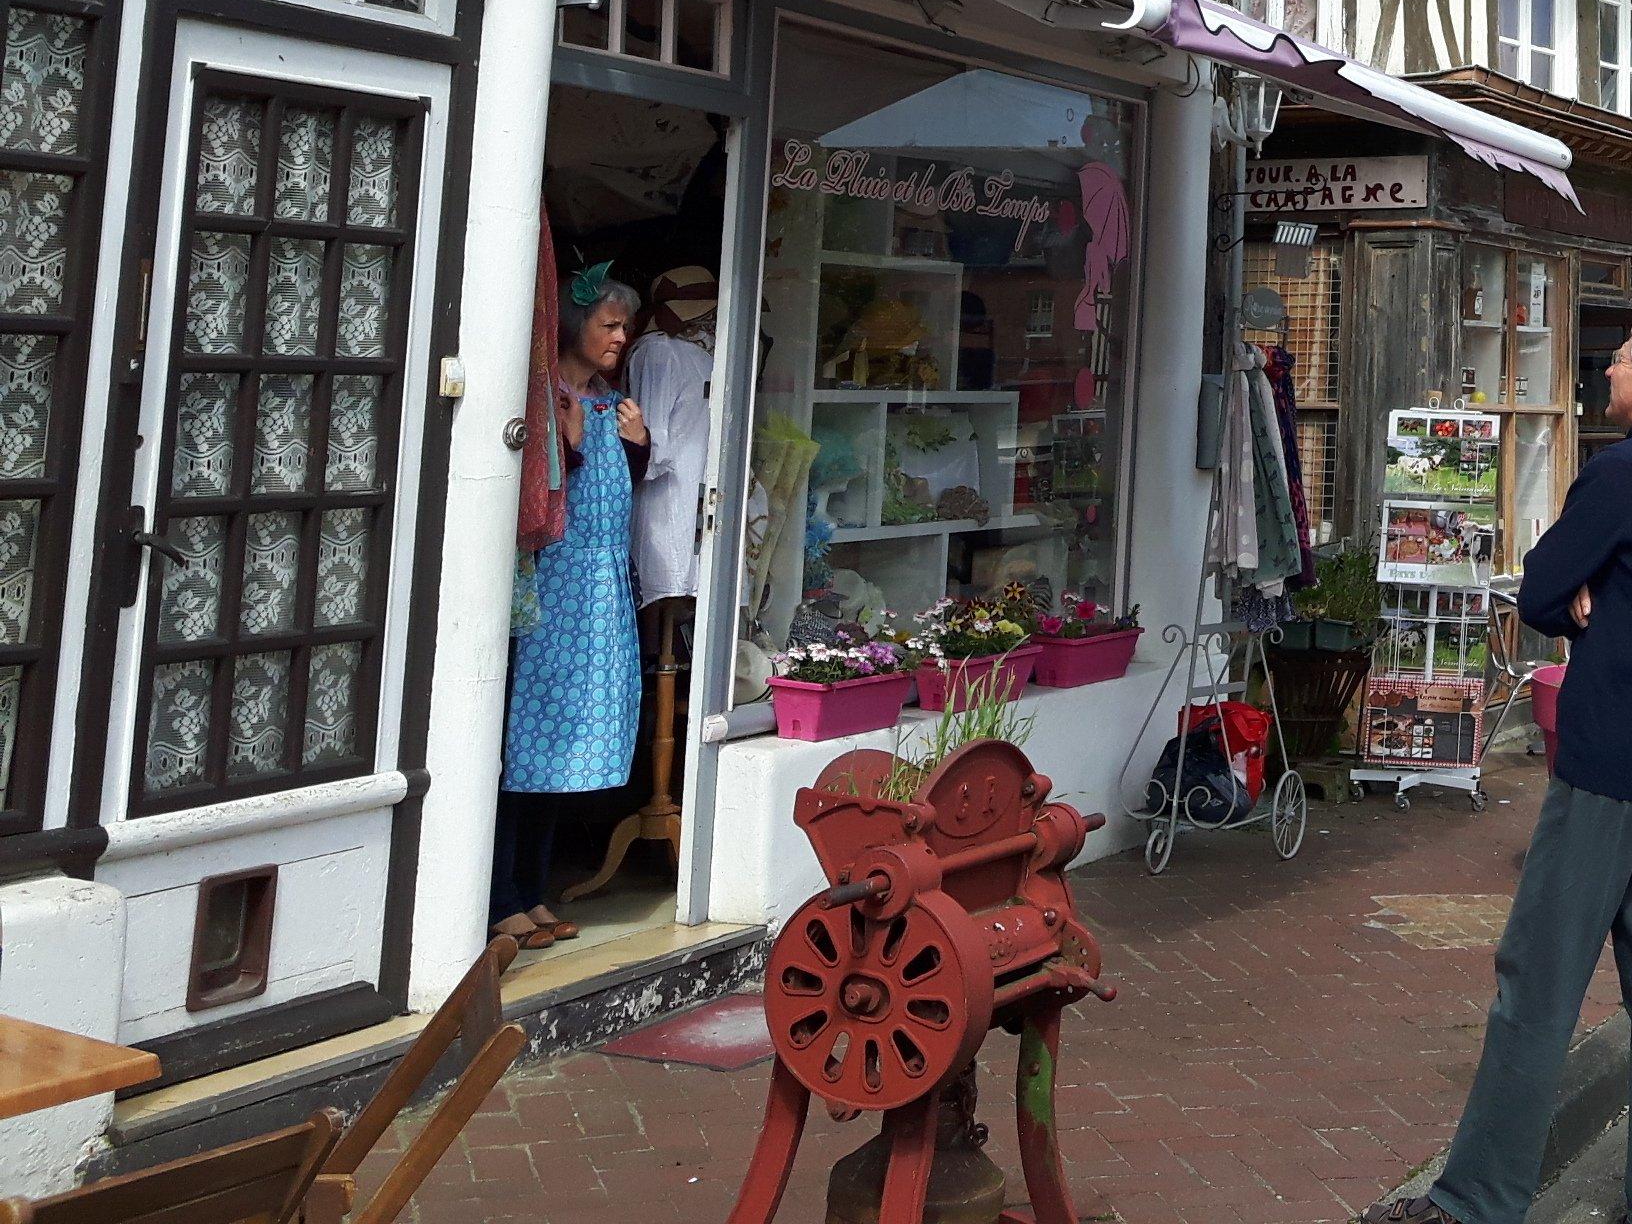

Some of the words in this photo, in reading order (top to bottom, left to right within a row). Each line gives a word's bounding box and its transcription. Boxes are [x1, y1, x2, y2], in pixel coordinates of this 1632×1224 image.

[771, 138, 818, 191] La
[819, 150, 891, 201] Pluie
[892, 171, 917, 203] et
[915, 163, 937, 207] le
[976, 168, 1050, 252] Temps
[1306, 164, 1320, 183] A
[1329, 164, 1358, 183] LA
